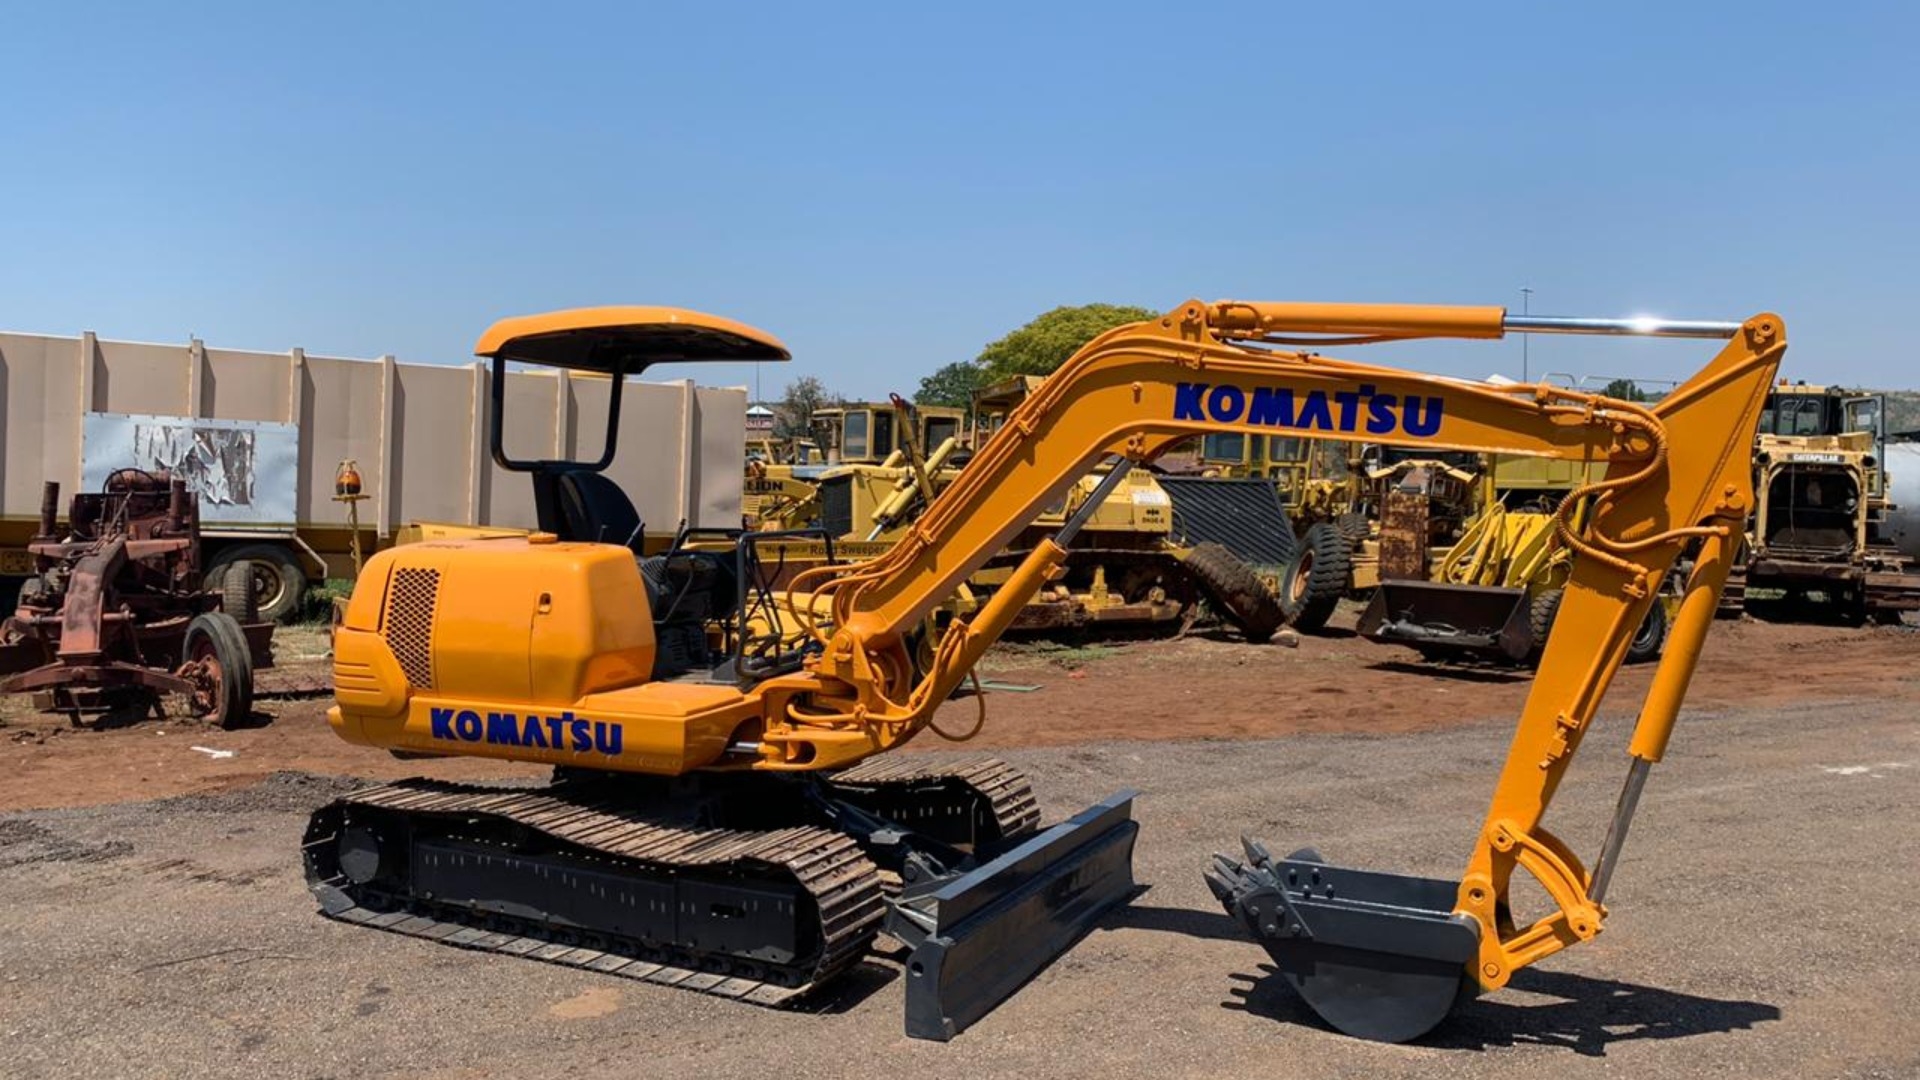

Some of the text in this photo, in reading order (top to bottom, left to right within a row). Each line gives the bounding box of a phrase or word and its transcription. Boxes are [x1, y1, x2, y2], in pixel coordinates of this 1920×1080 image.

[1174, 382, 1444, 437] KOMATSU
[744, 481, 783, 491] LION
[430, 707, 623, 755] KOMATSU
